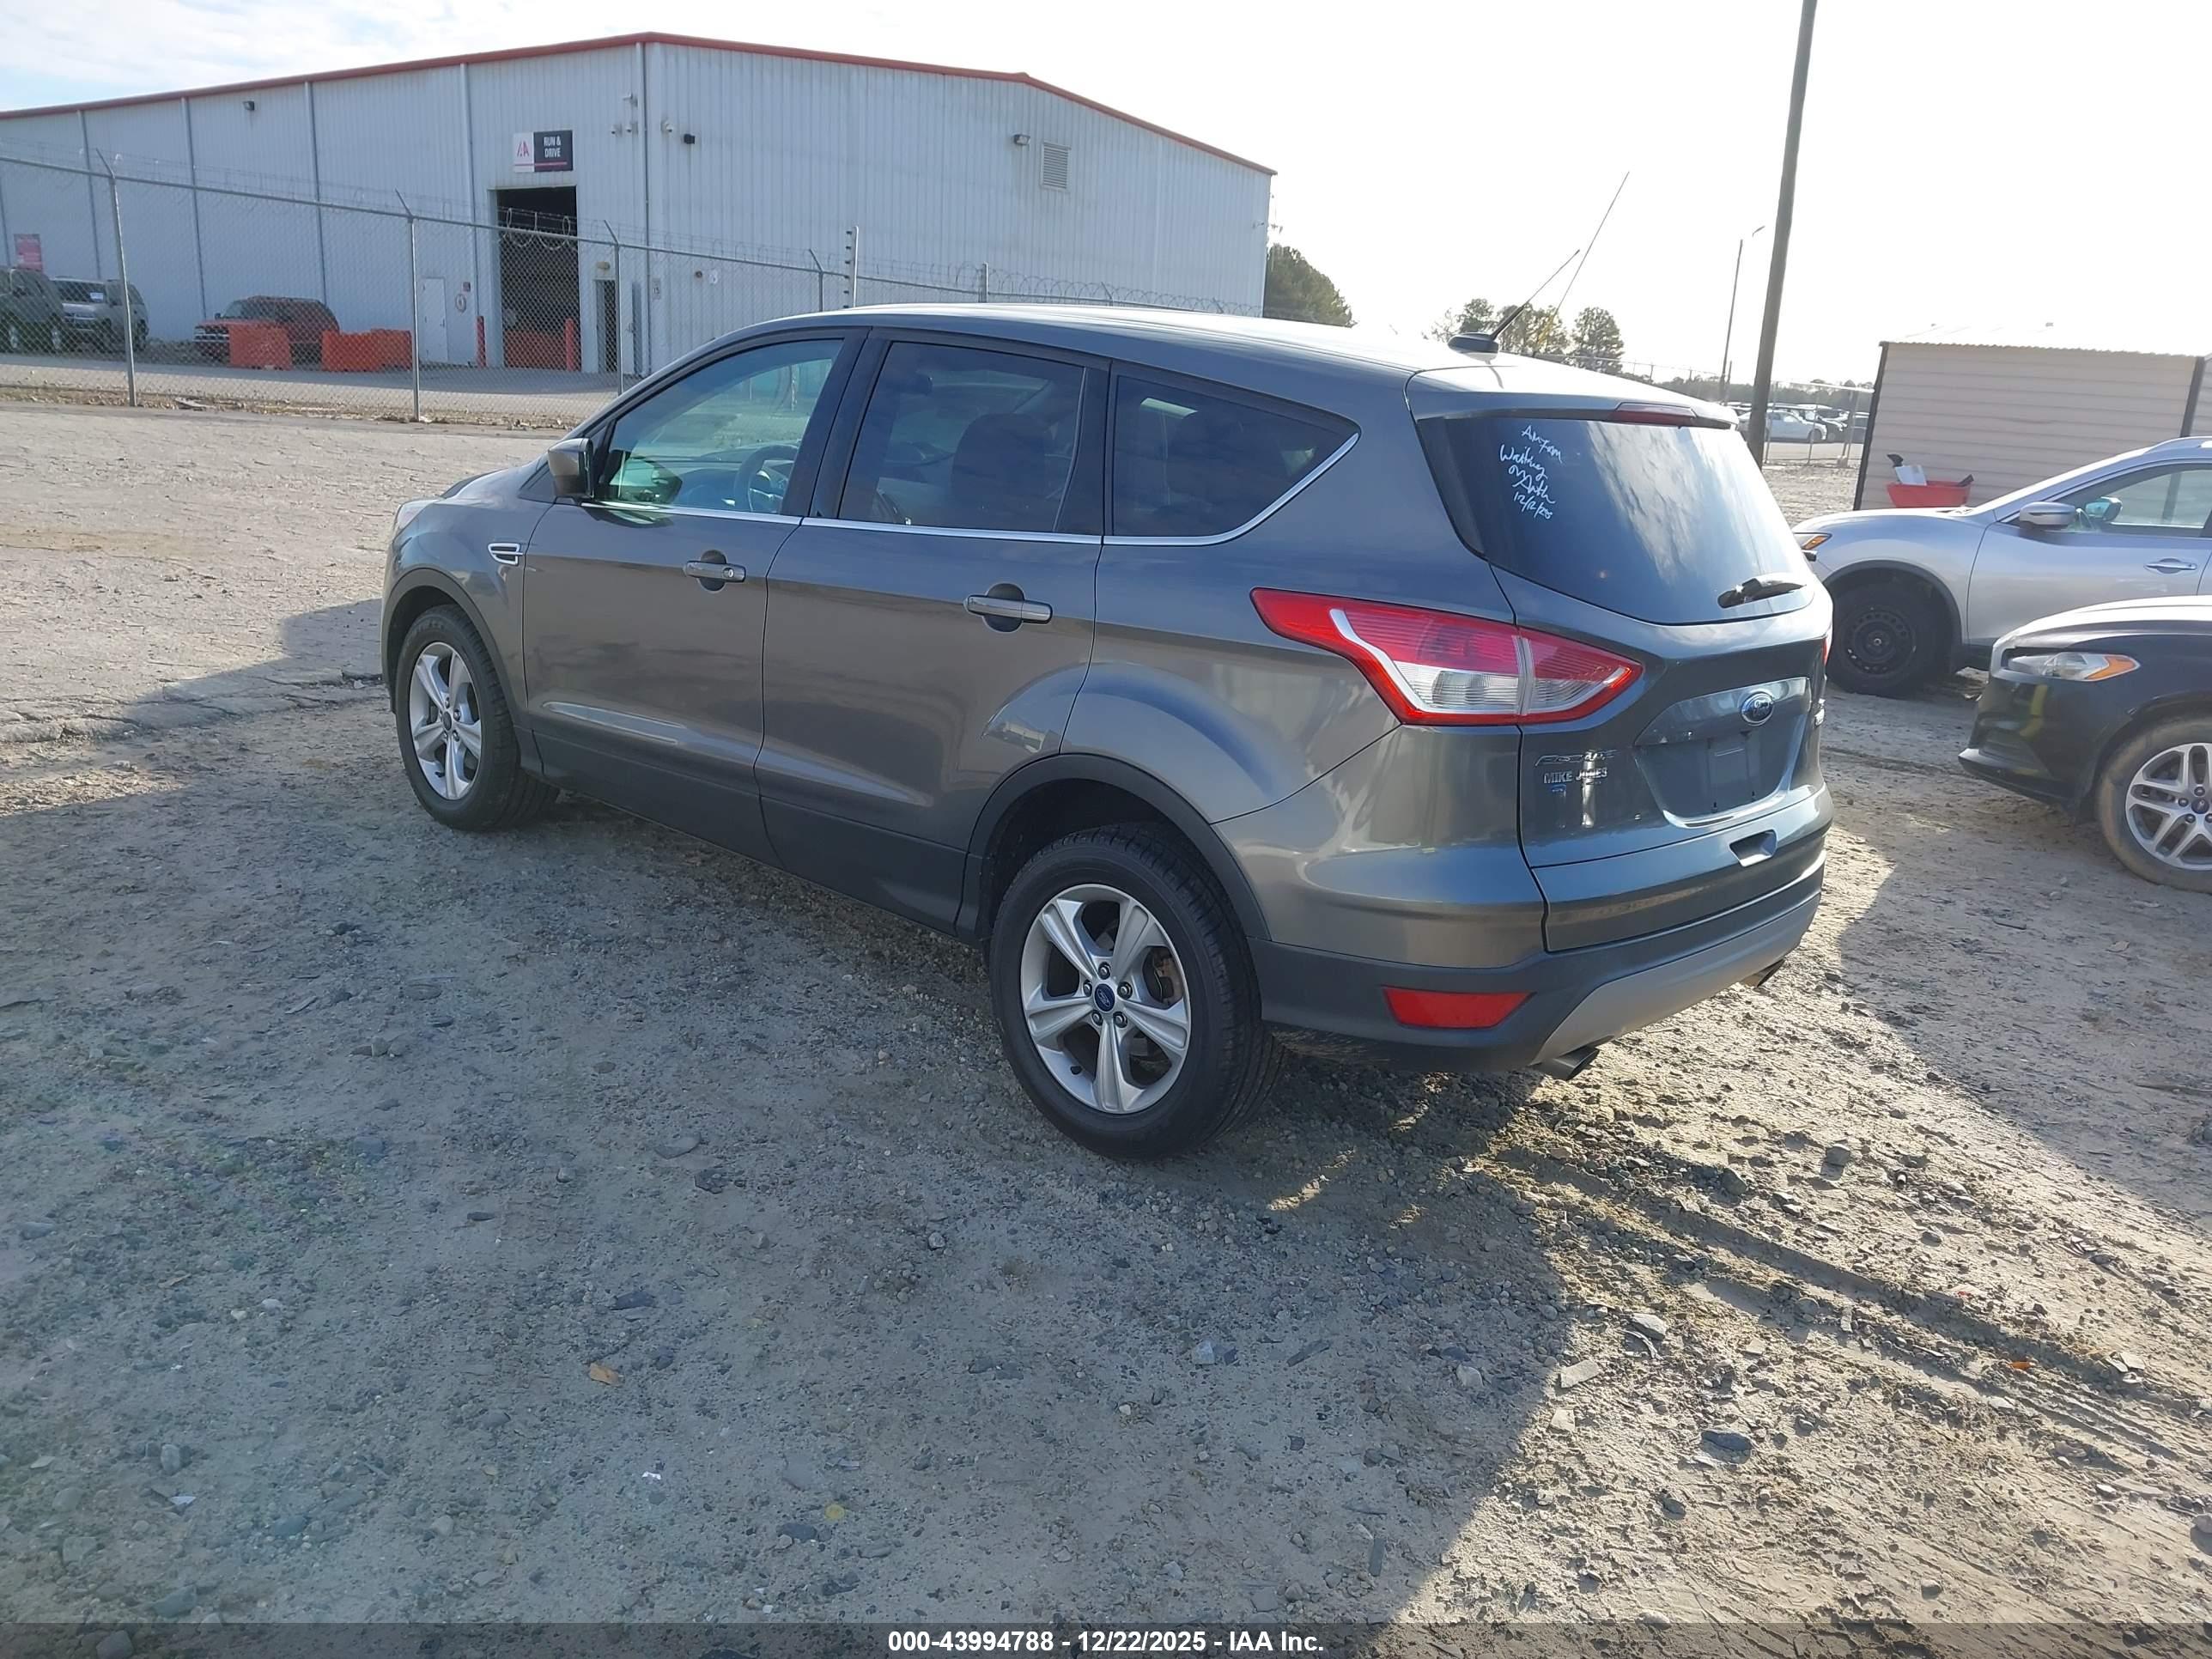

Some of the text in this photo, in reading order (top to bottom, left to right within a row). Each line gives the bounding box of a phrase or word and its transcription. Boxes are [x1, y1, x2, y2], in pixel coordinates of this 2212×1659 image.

[544, 136, 562, 147] RUN &
[544, 148, 562, 158] DRIVE
[1544, 770, 1573, 784] MIKE
